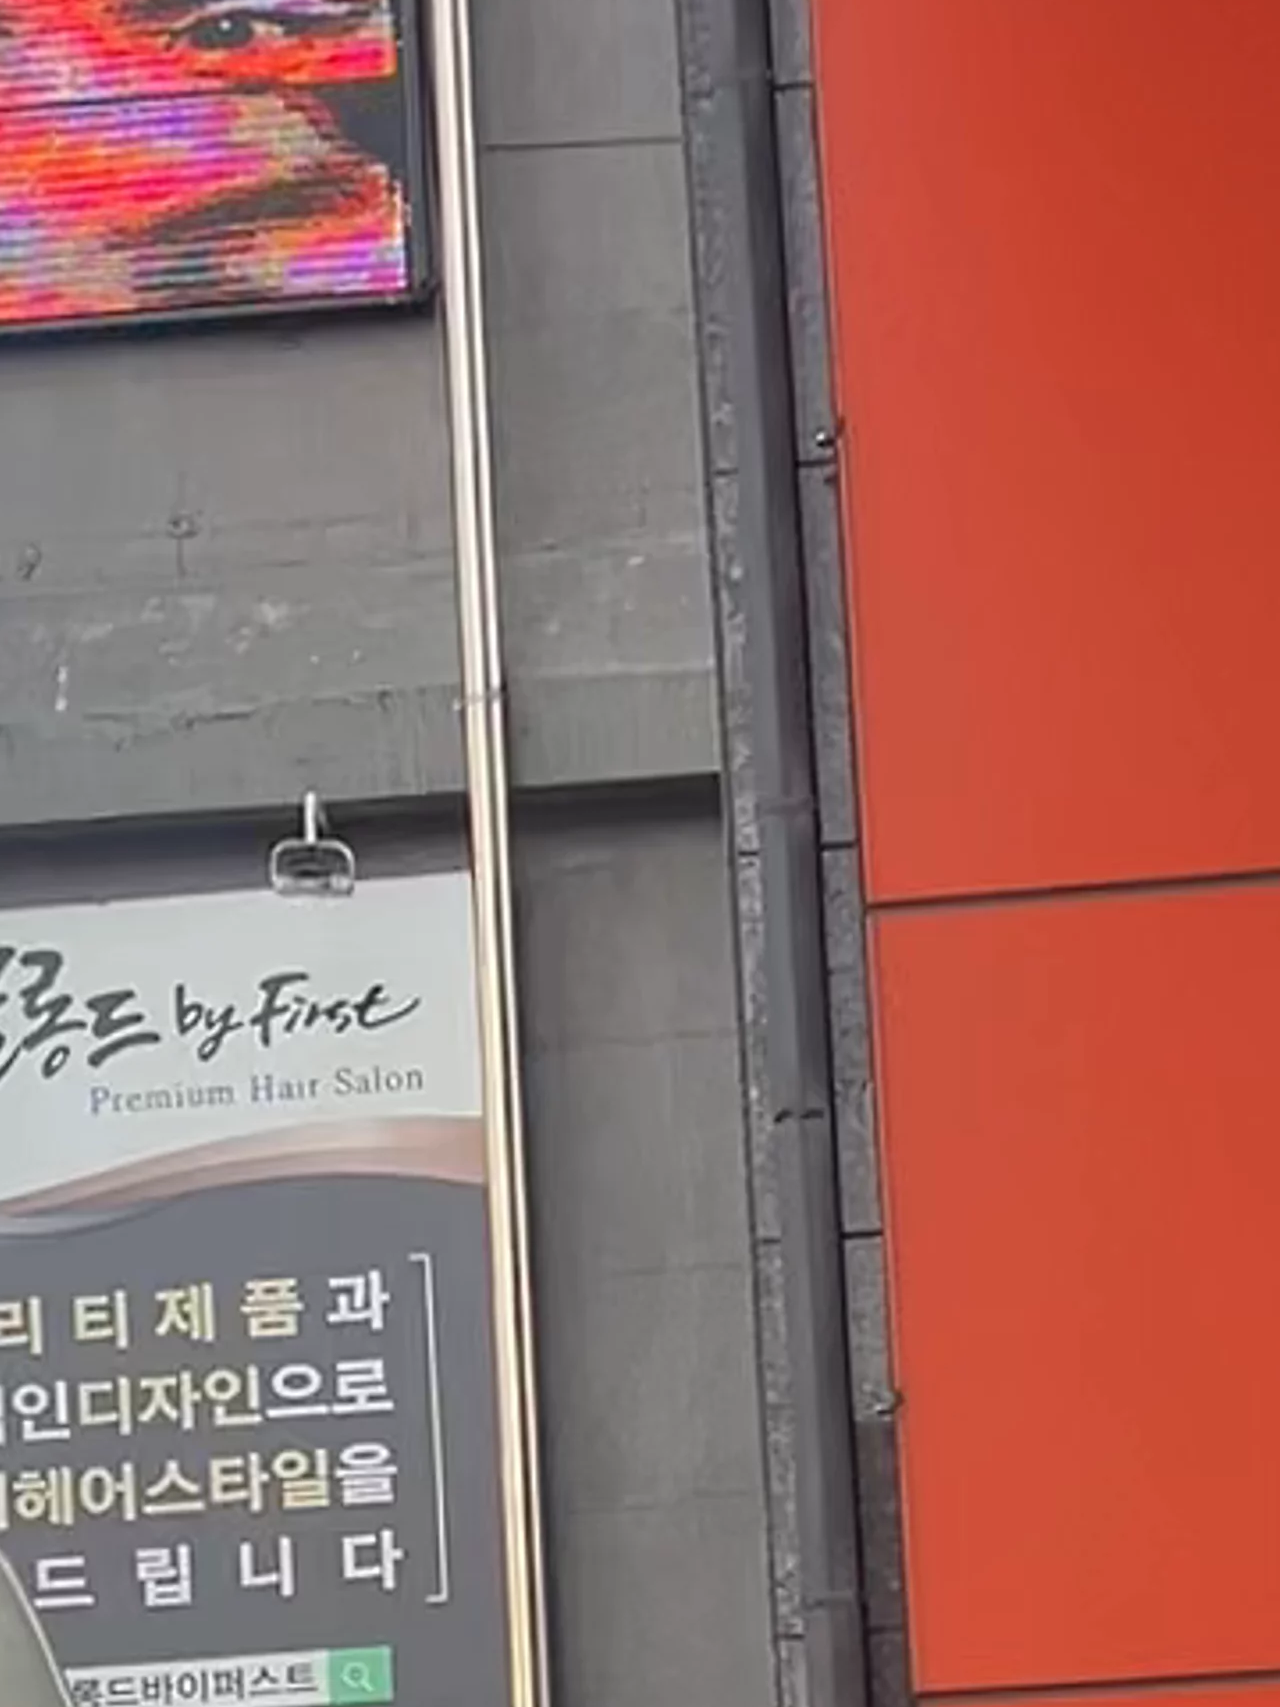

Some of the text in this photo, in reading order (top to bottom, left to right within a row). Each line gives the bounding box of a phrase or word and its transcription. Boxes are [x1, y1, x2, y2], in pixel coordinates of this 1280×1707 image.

[173, 984, 245, 1061] by
[248, 972, 422, 1047] First
[90, 1065, 423, 1115] Premium Hair Salon
